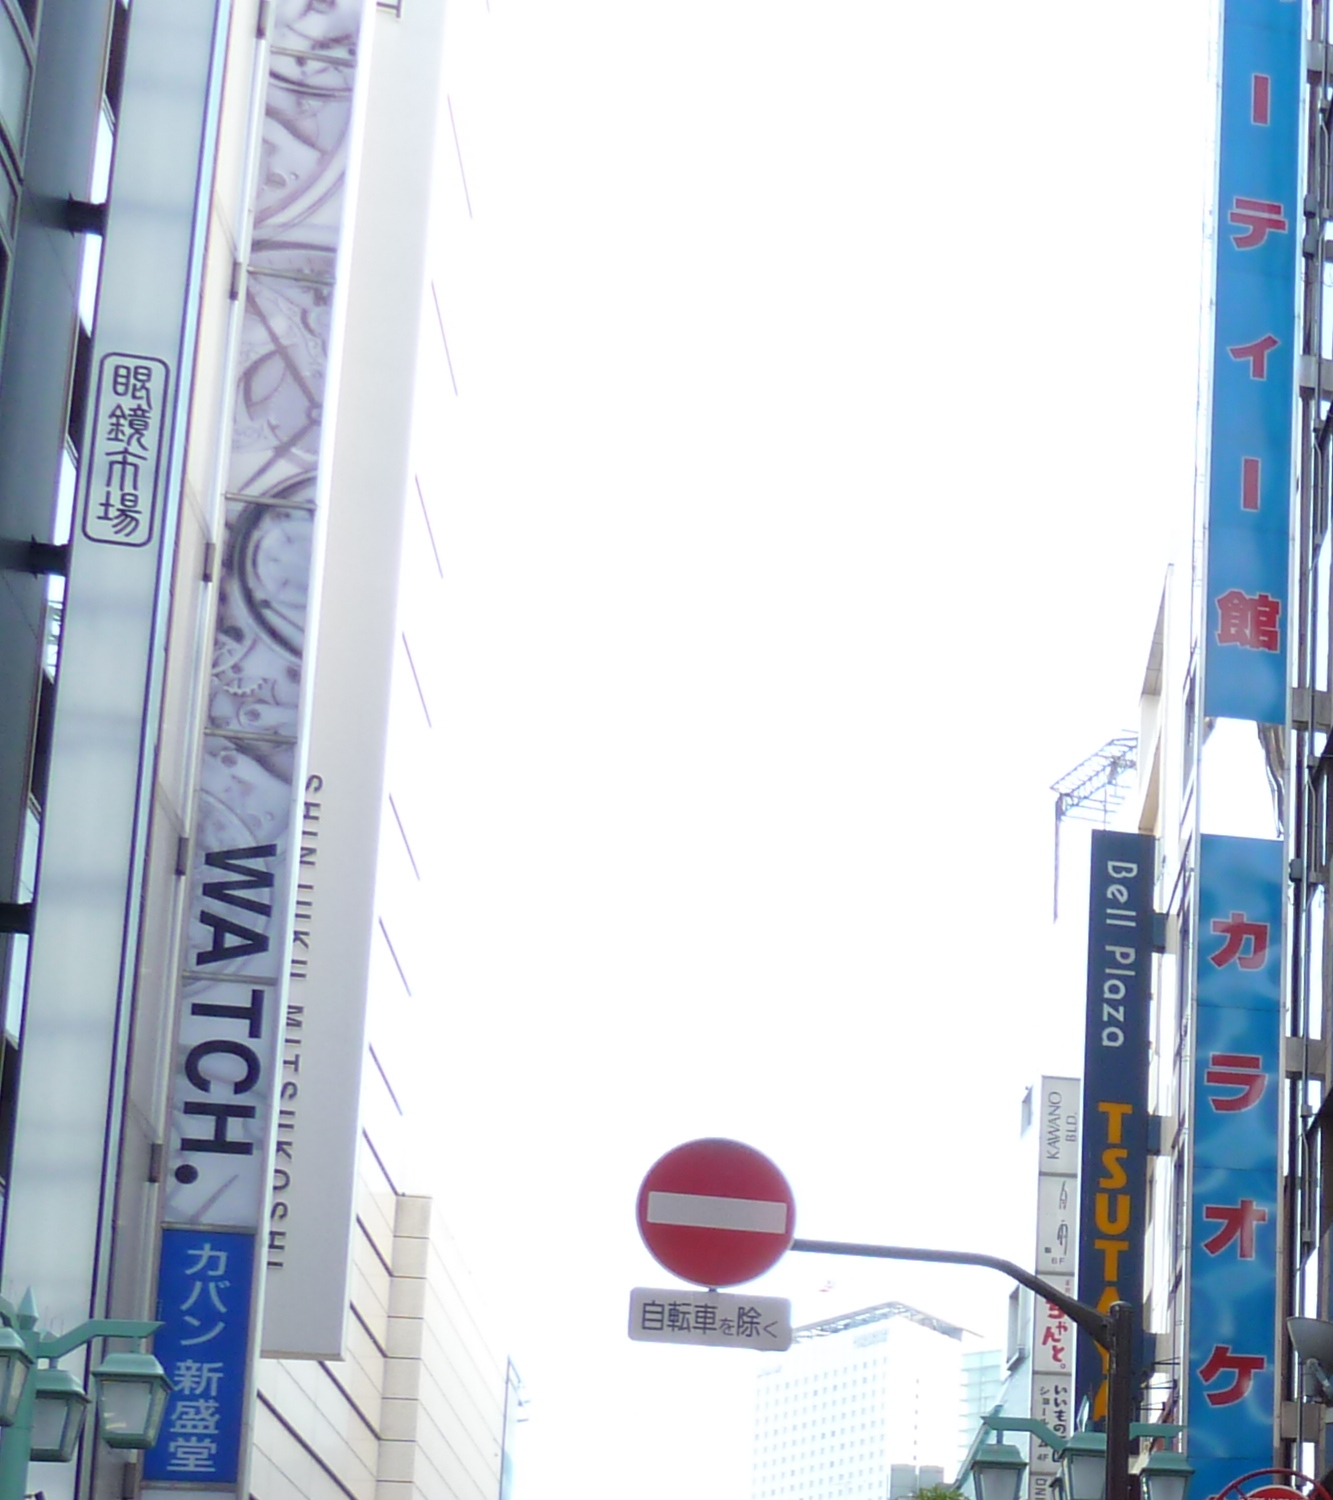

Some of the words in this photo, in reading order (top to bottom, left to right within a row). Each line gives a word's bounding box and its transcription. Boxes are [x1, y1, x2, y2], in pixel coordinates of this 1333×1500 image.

[97, 364, 153, 539] 眼鏡市場
[1104, 860, 1138, 926] Bell
[173, 843, 279, 1185] WATCH.
[1101, 946, 1137, 1049] Plaza
[1046, 1091, 1062, 1160] KAWANO
[1065, 1111, 1077, 1143] BLD.
[178, 1242, 229, 1347] カバン
[639, 1300, 778, 1342] 自転車を除く
[165, 1359, 224, 1473] 新盛堂
